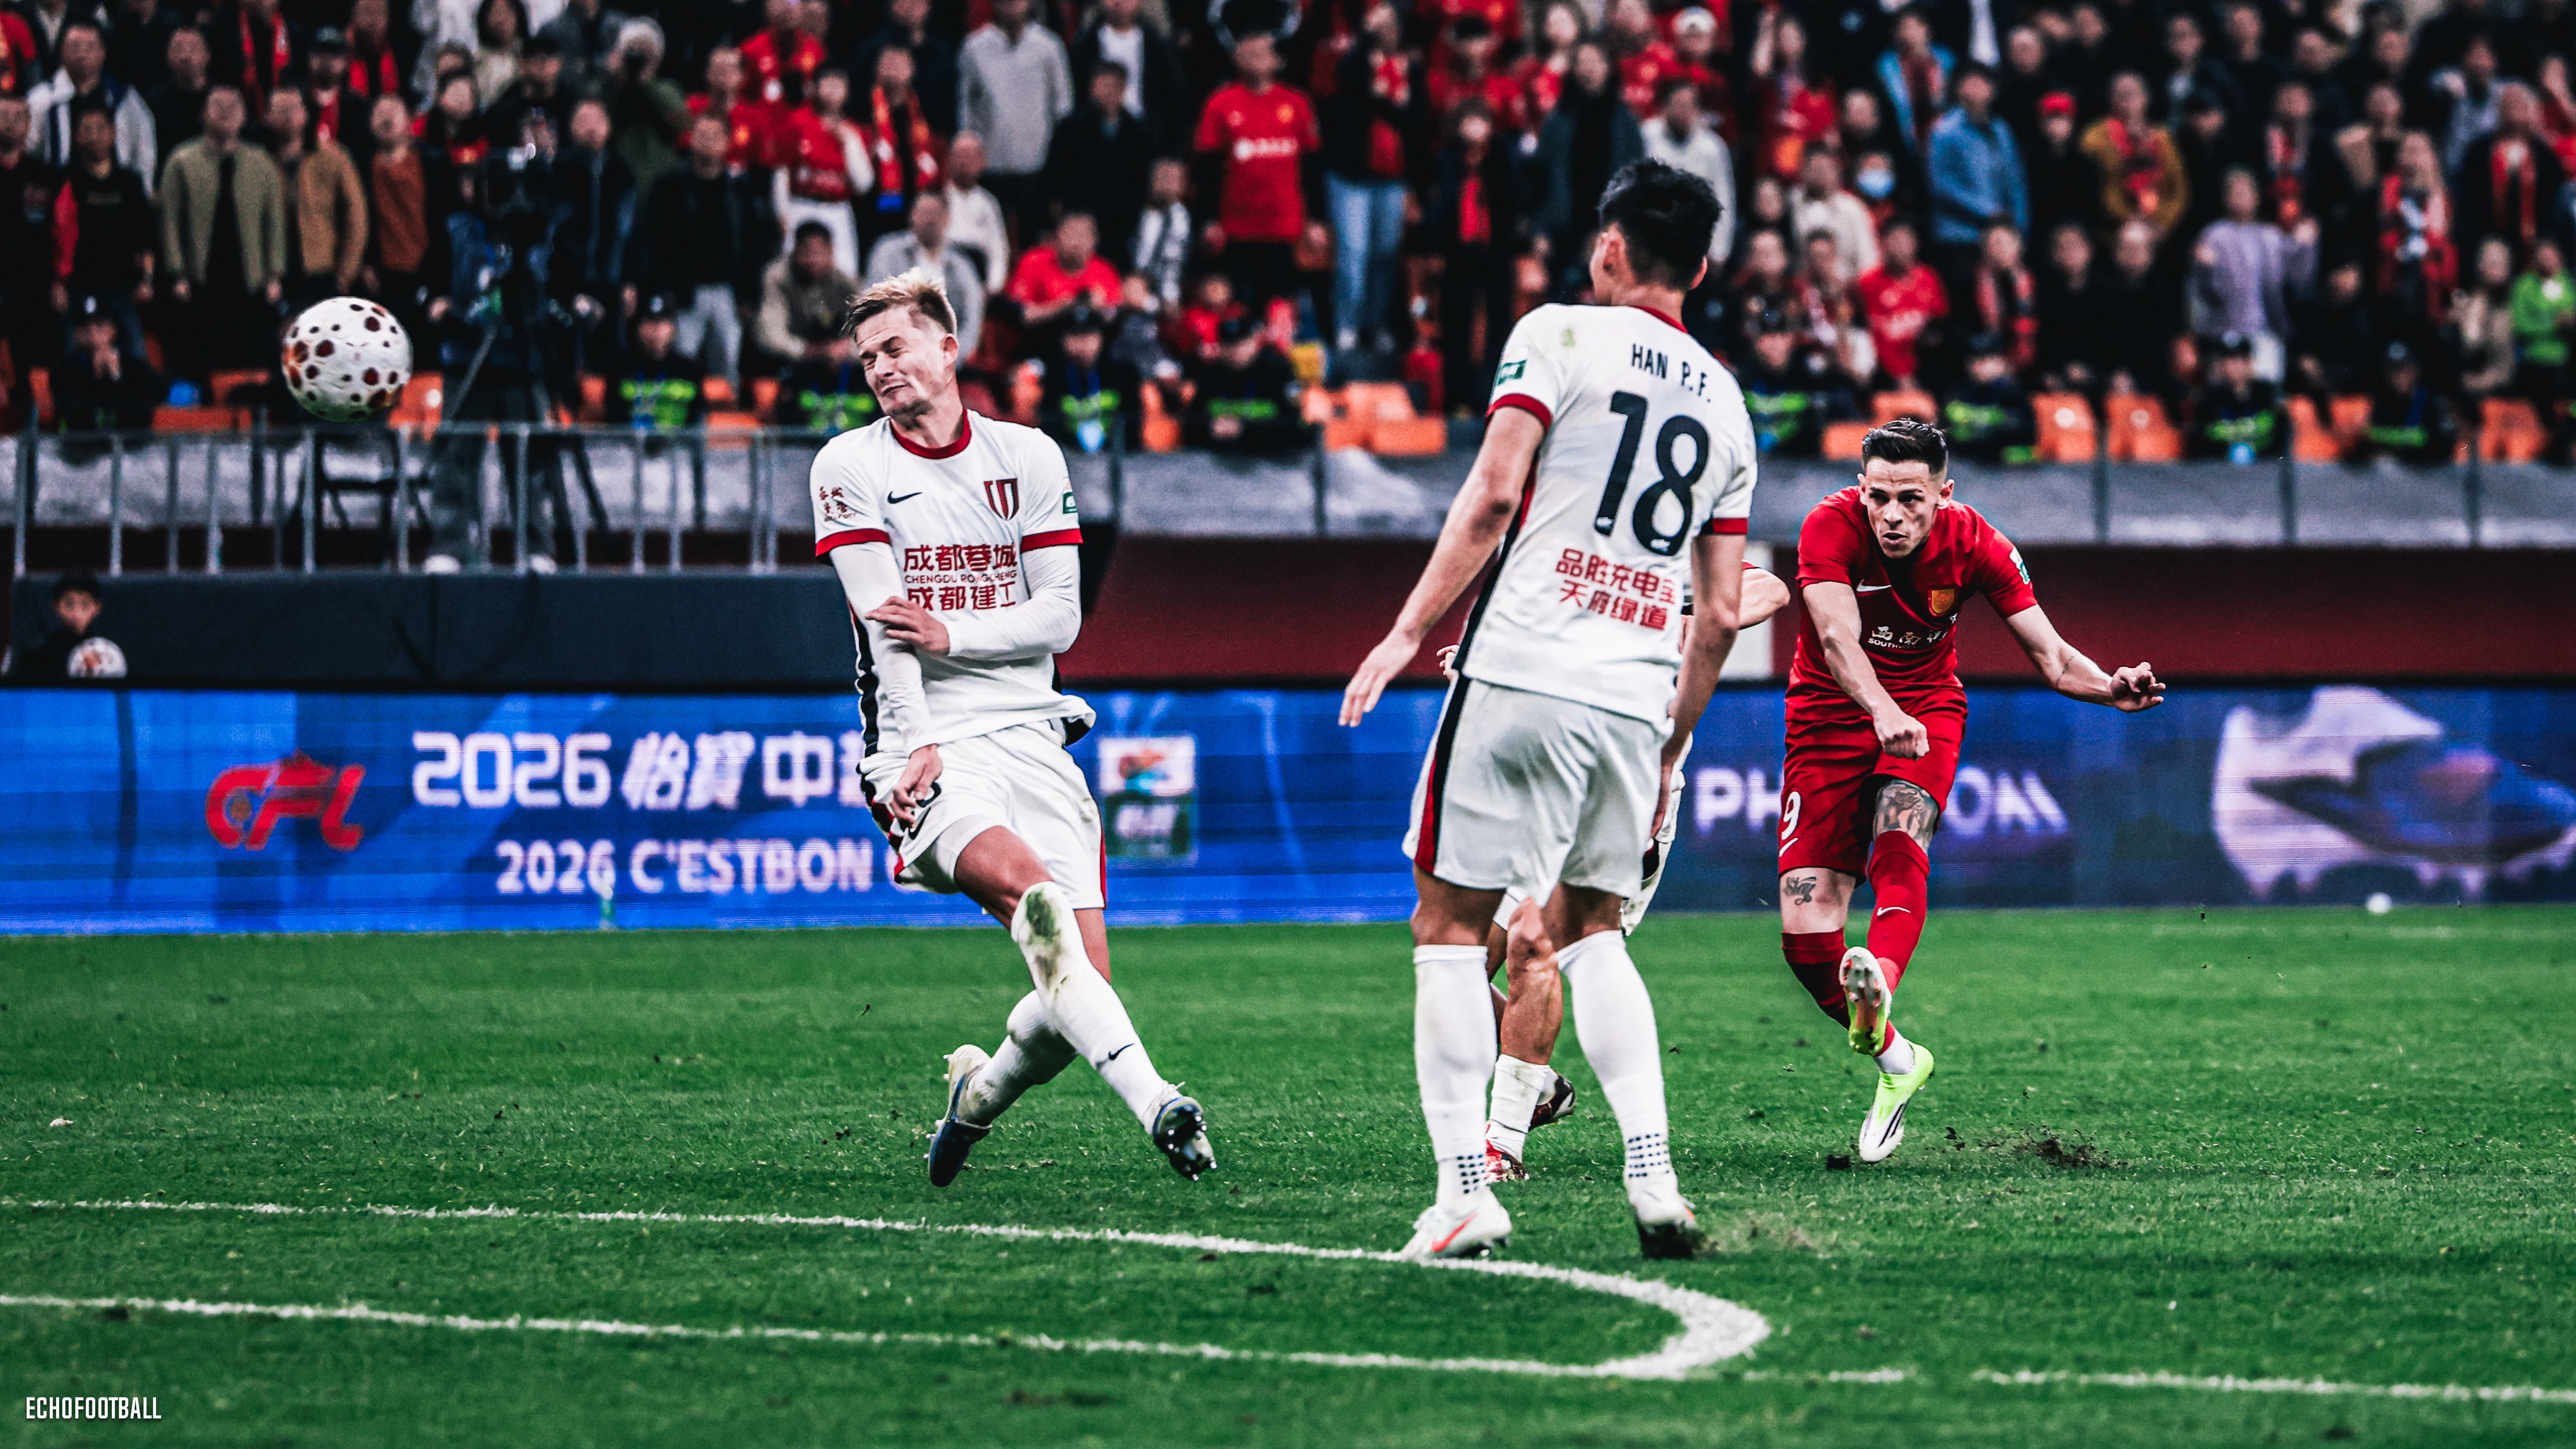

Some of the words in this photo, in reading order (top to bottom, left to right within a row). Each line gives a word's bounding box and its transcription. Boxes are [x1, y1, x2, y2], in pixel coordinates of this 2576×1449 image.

[1631, 343, 1668, 380] HAN
[1681, 360, 1711, 403] P.F.
[1594, 390, 1711, 557] 18
[903, 542, 1018, 573] 成都蓉城
[904, 574, 957, 584] CHENGDU
[907, 581, 1017, 611] 成都建工
[411, 731, 612, 809] 2026
[204, 762, 367, 851] CFL
[1694, 765, 2071, 838] PHOM
[1781, 790, 1801, 840] 9
[495, 839, 616, 895] 2026
[629, 838, 874, 894] C'ESTBON
